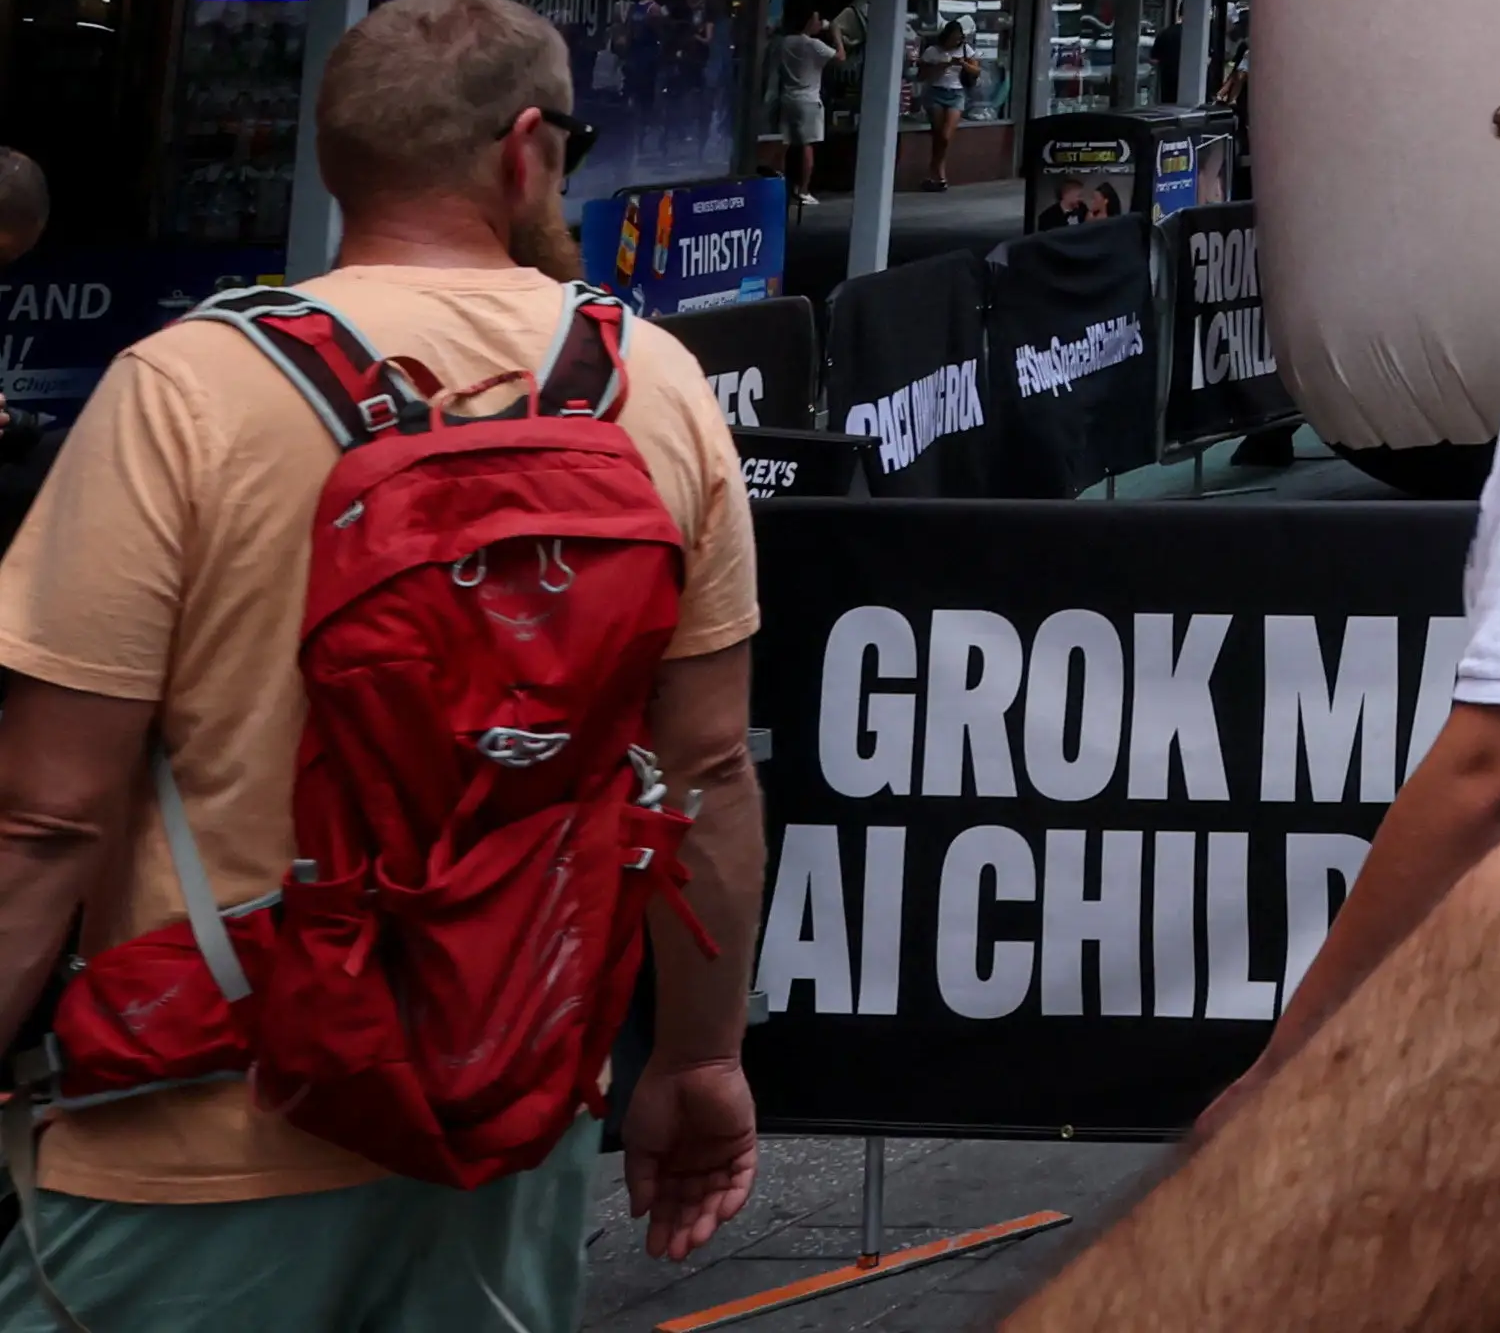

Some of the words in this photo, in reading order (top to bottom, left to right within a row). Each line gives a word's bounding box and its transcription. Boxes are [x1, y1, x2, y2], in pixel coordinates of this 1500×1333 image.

[678, 227, 763, 279] THIRSTY?
[738, 457, 799, 488] CEX'S
[818, 605, 1229, 803] GROK
[753, 824, 903, 1016] AI
